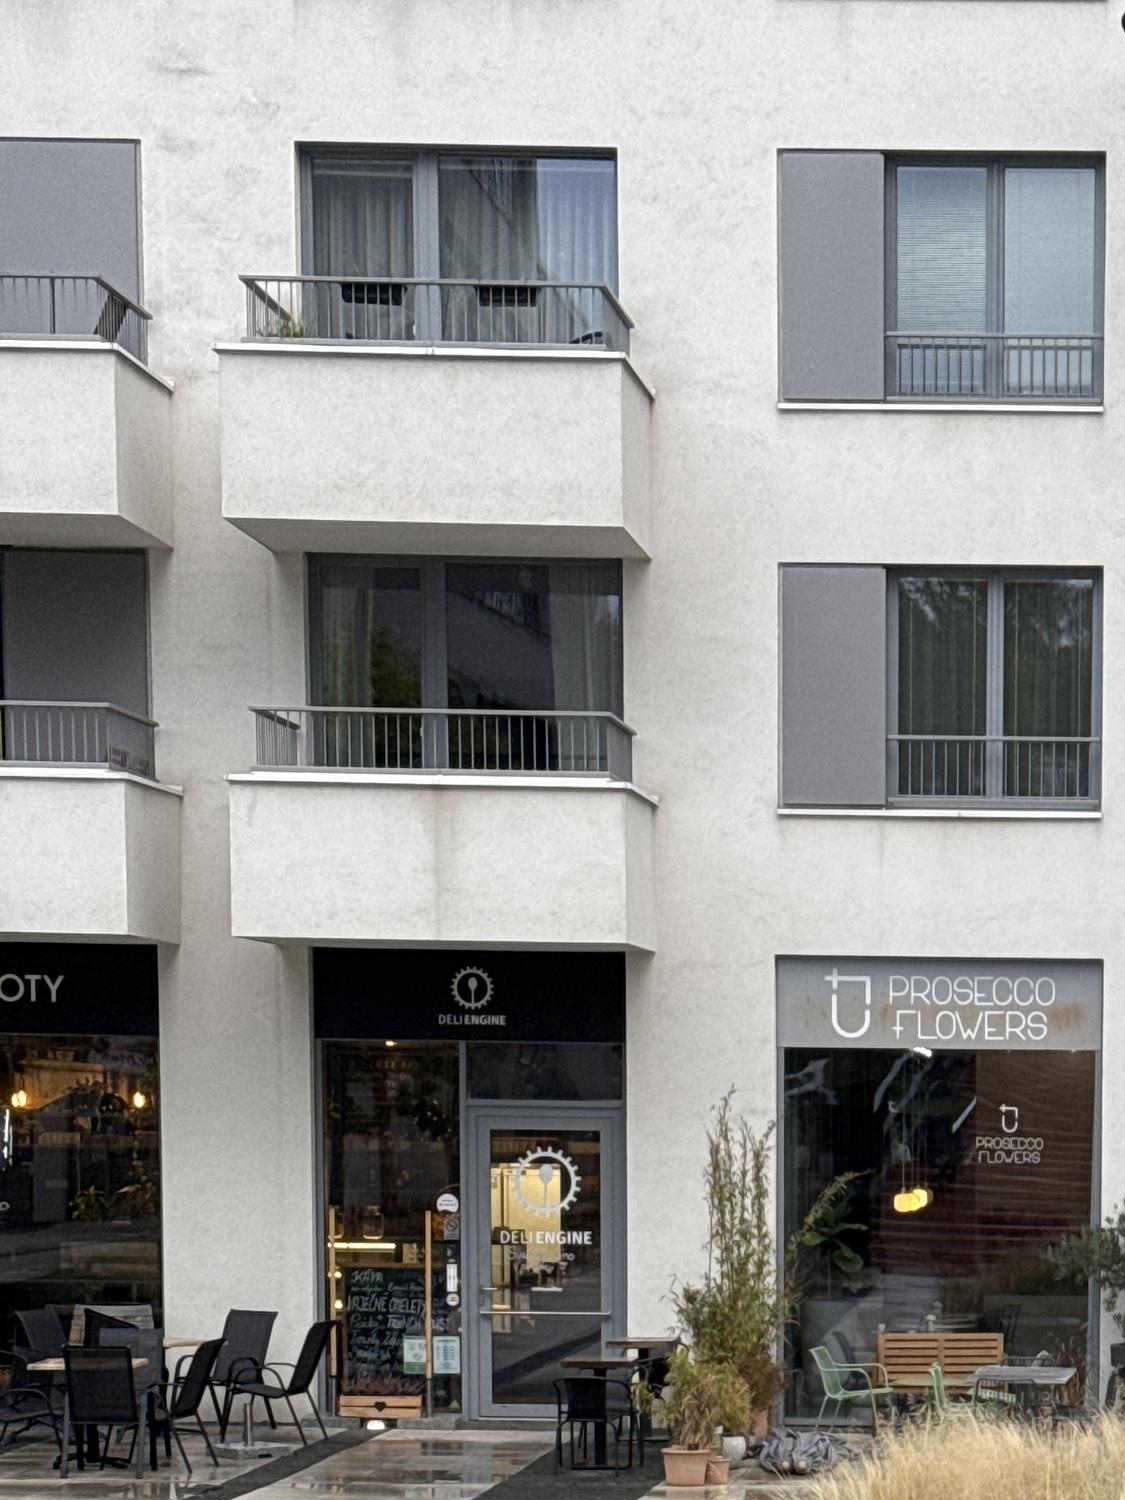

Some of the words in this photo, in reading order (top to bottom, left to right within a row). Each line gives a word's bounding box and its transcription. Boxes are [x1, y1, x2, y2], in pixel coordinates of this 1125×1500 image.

[889, 975, 1056, 1006] PROSECCO
[892, 1010, 1048, 1040] FLOWERS
[975, 1136, 1044, 1150] PROSECCO
[978, 1150, 1041, 1164] FLOWERS
